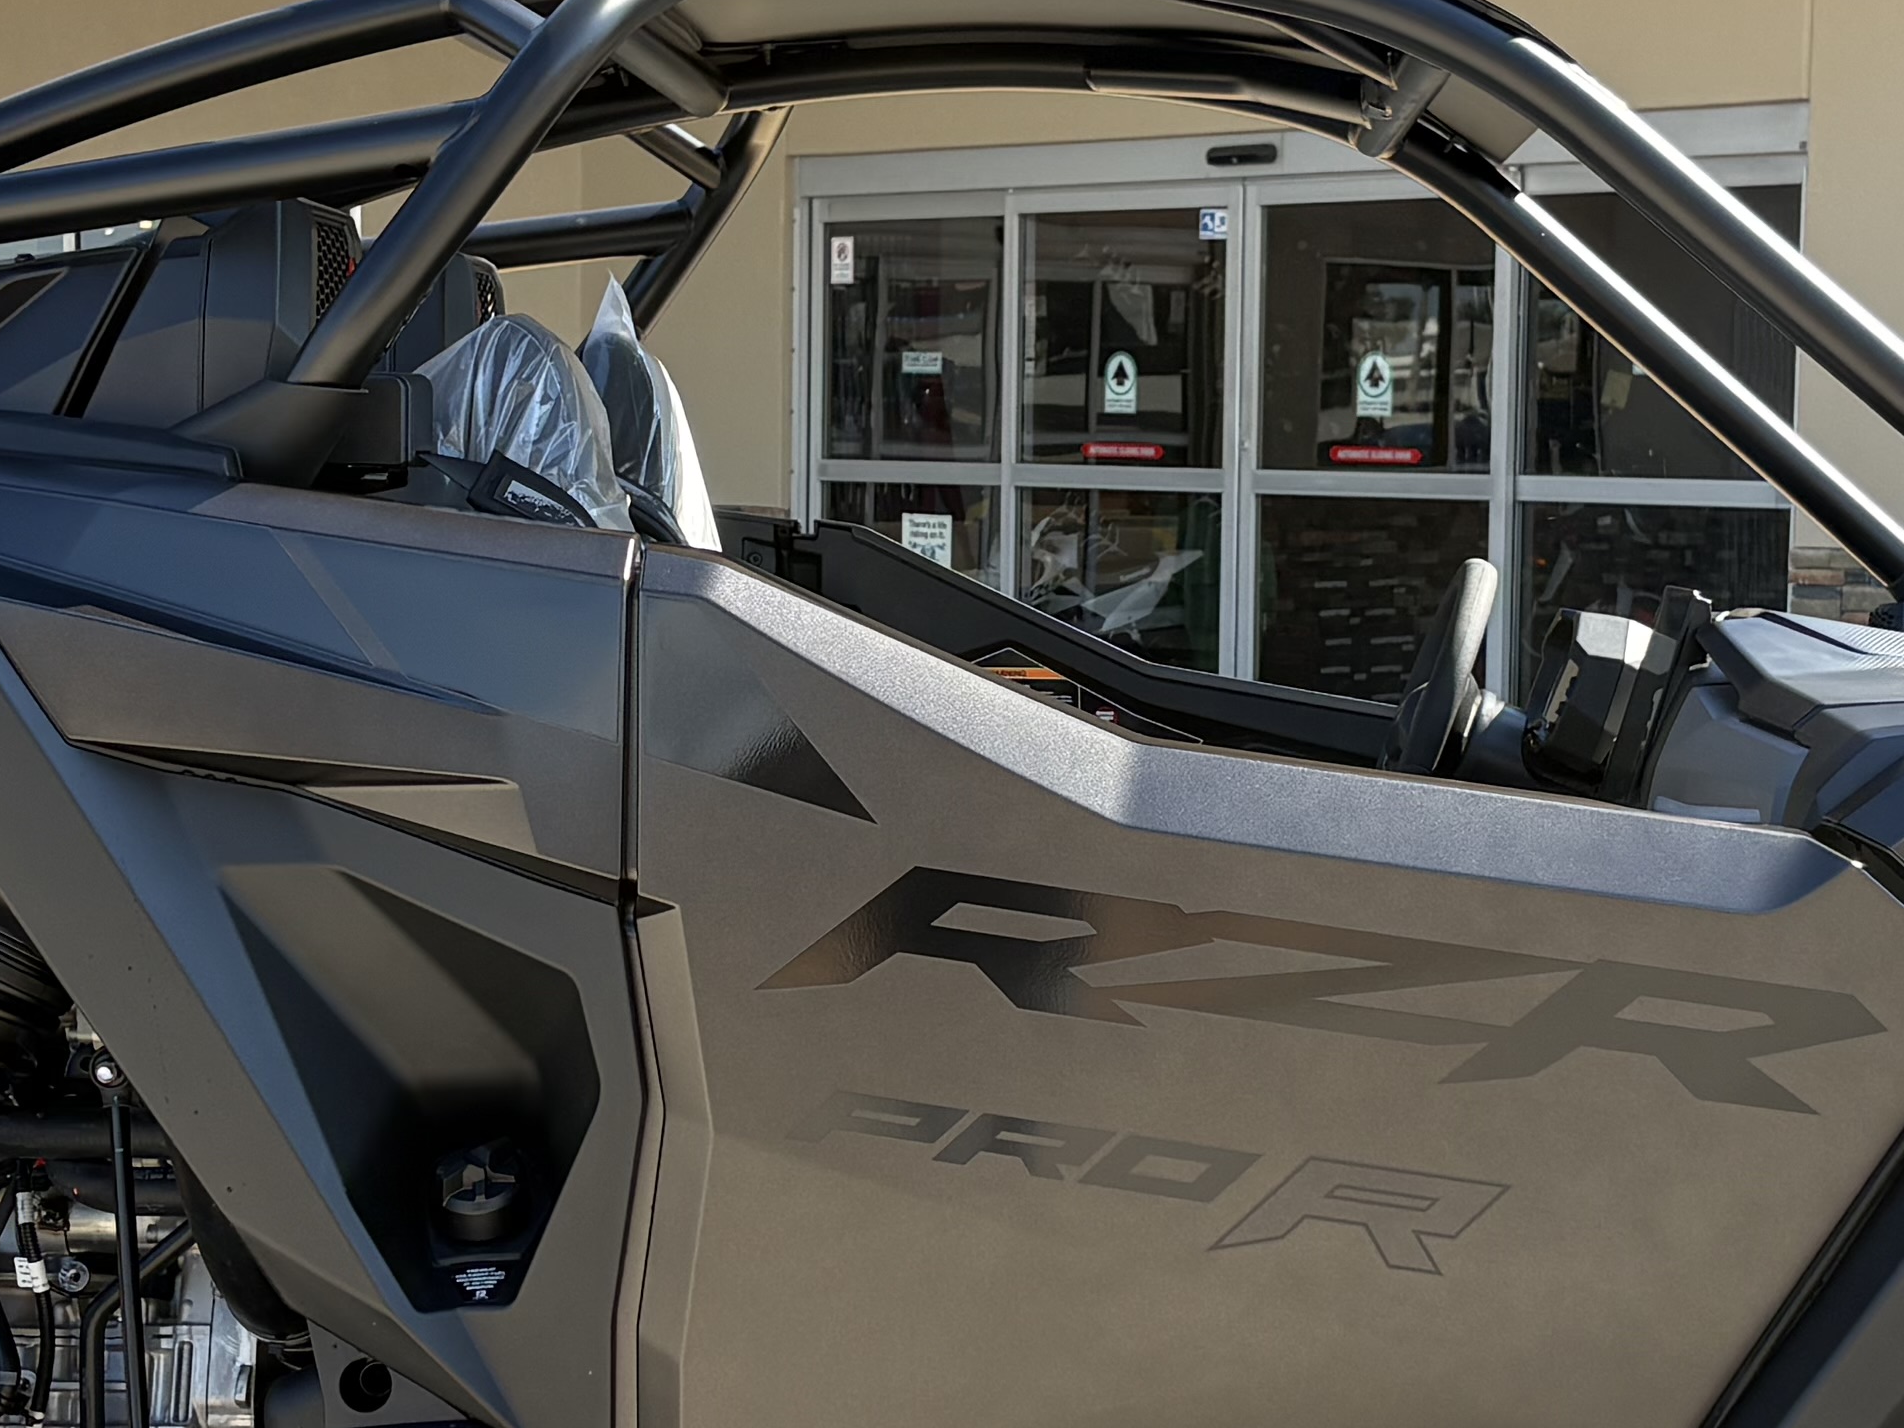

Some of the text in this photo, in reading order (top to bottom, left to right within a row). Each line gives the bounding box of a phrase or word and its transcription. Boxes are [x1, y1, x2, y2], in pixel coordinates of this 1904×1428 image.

[754, 866, 1887, 1115] RZR
[787, 1090, 1511, 1275] PRO R
